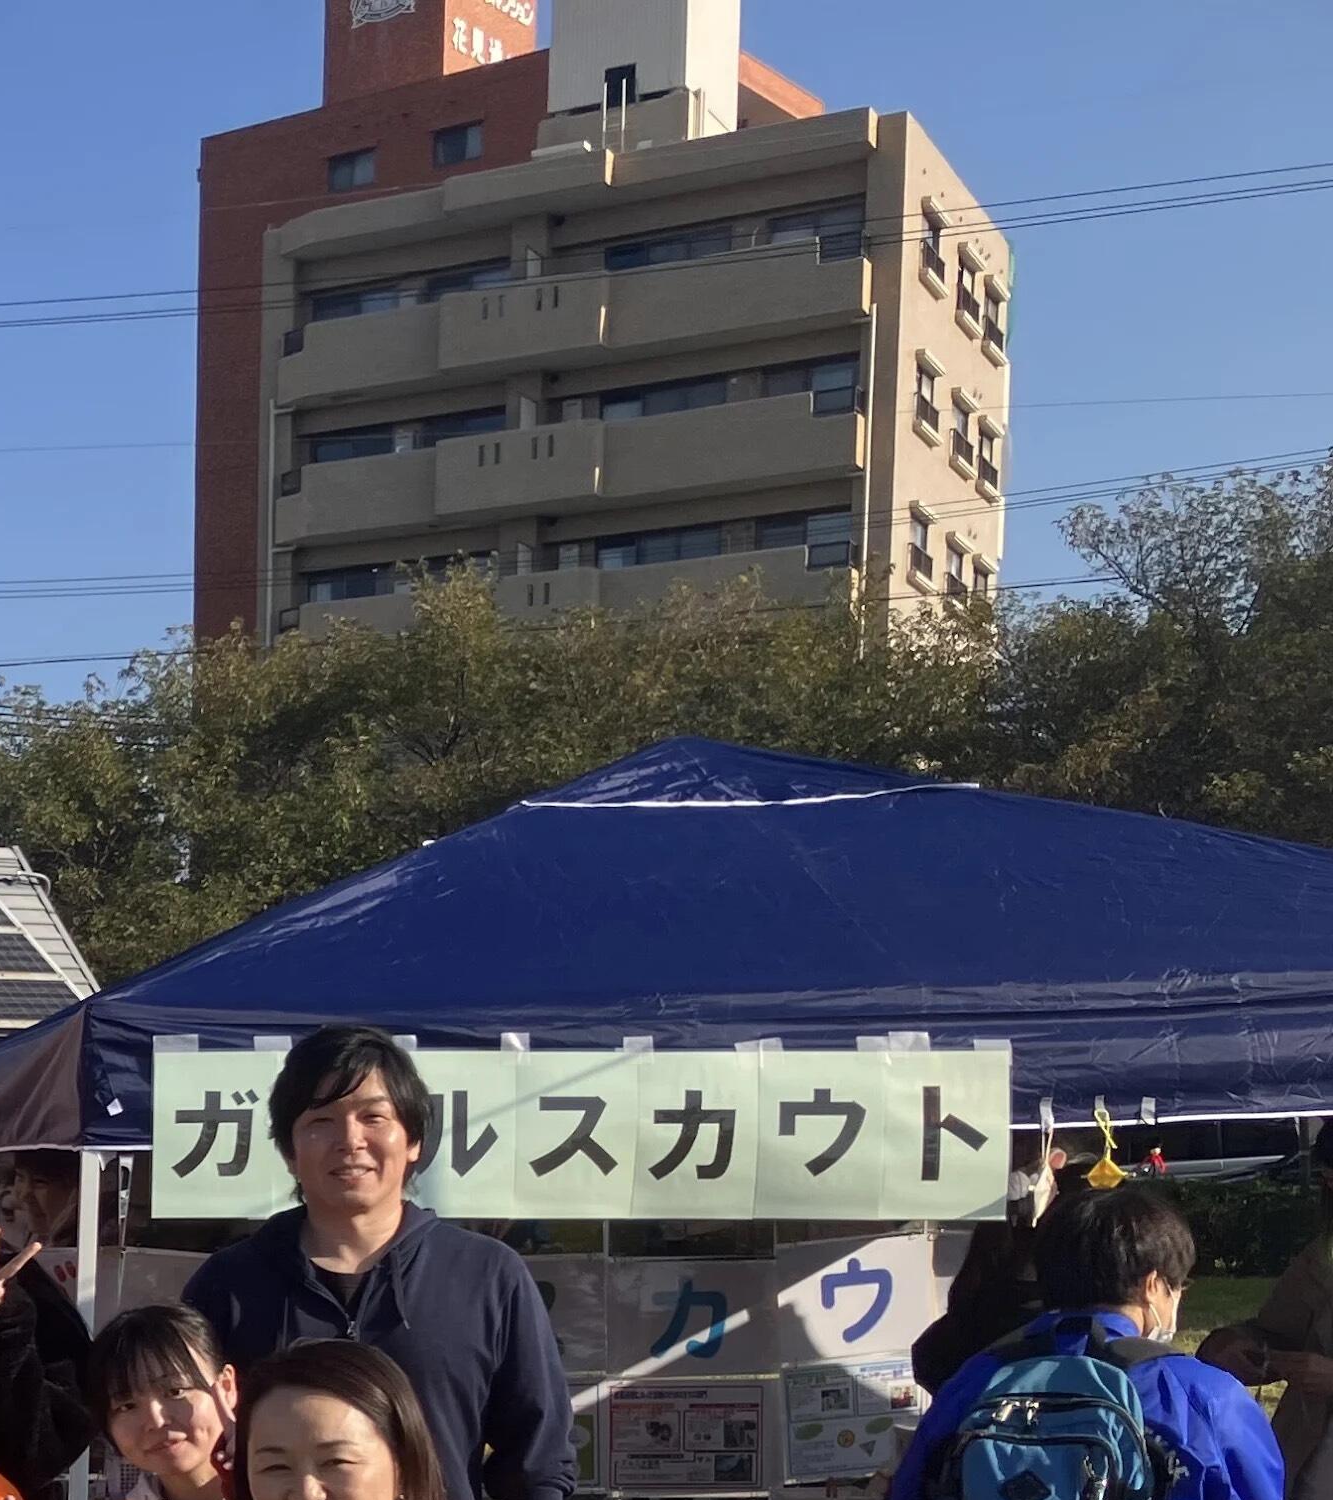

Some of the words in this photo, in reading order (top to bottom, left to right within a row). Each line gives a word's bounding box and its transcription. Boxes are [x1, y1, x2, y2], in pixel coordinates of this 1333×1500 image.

[172, 1086, 990, 1183] ガルスカウト
